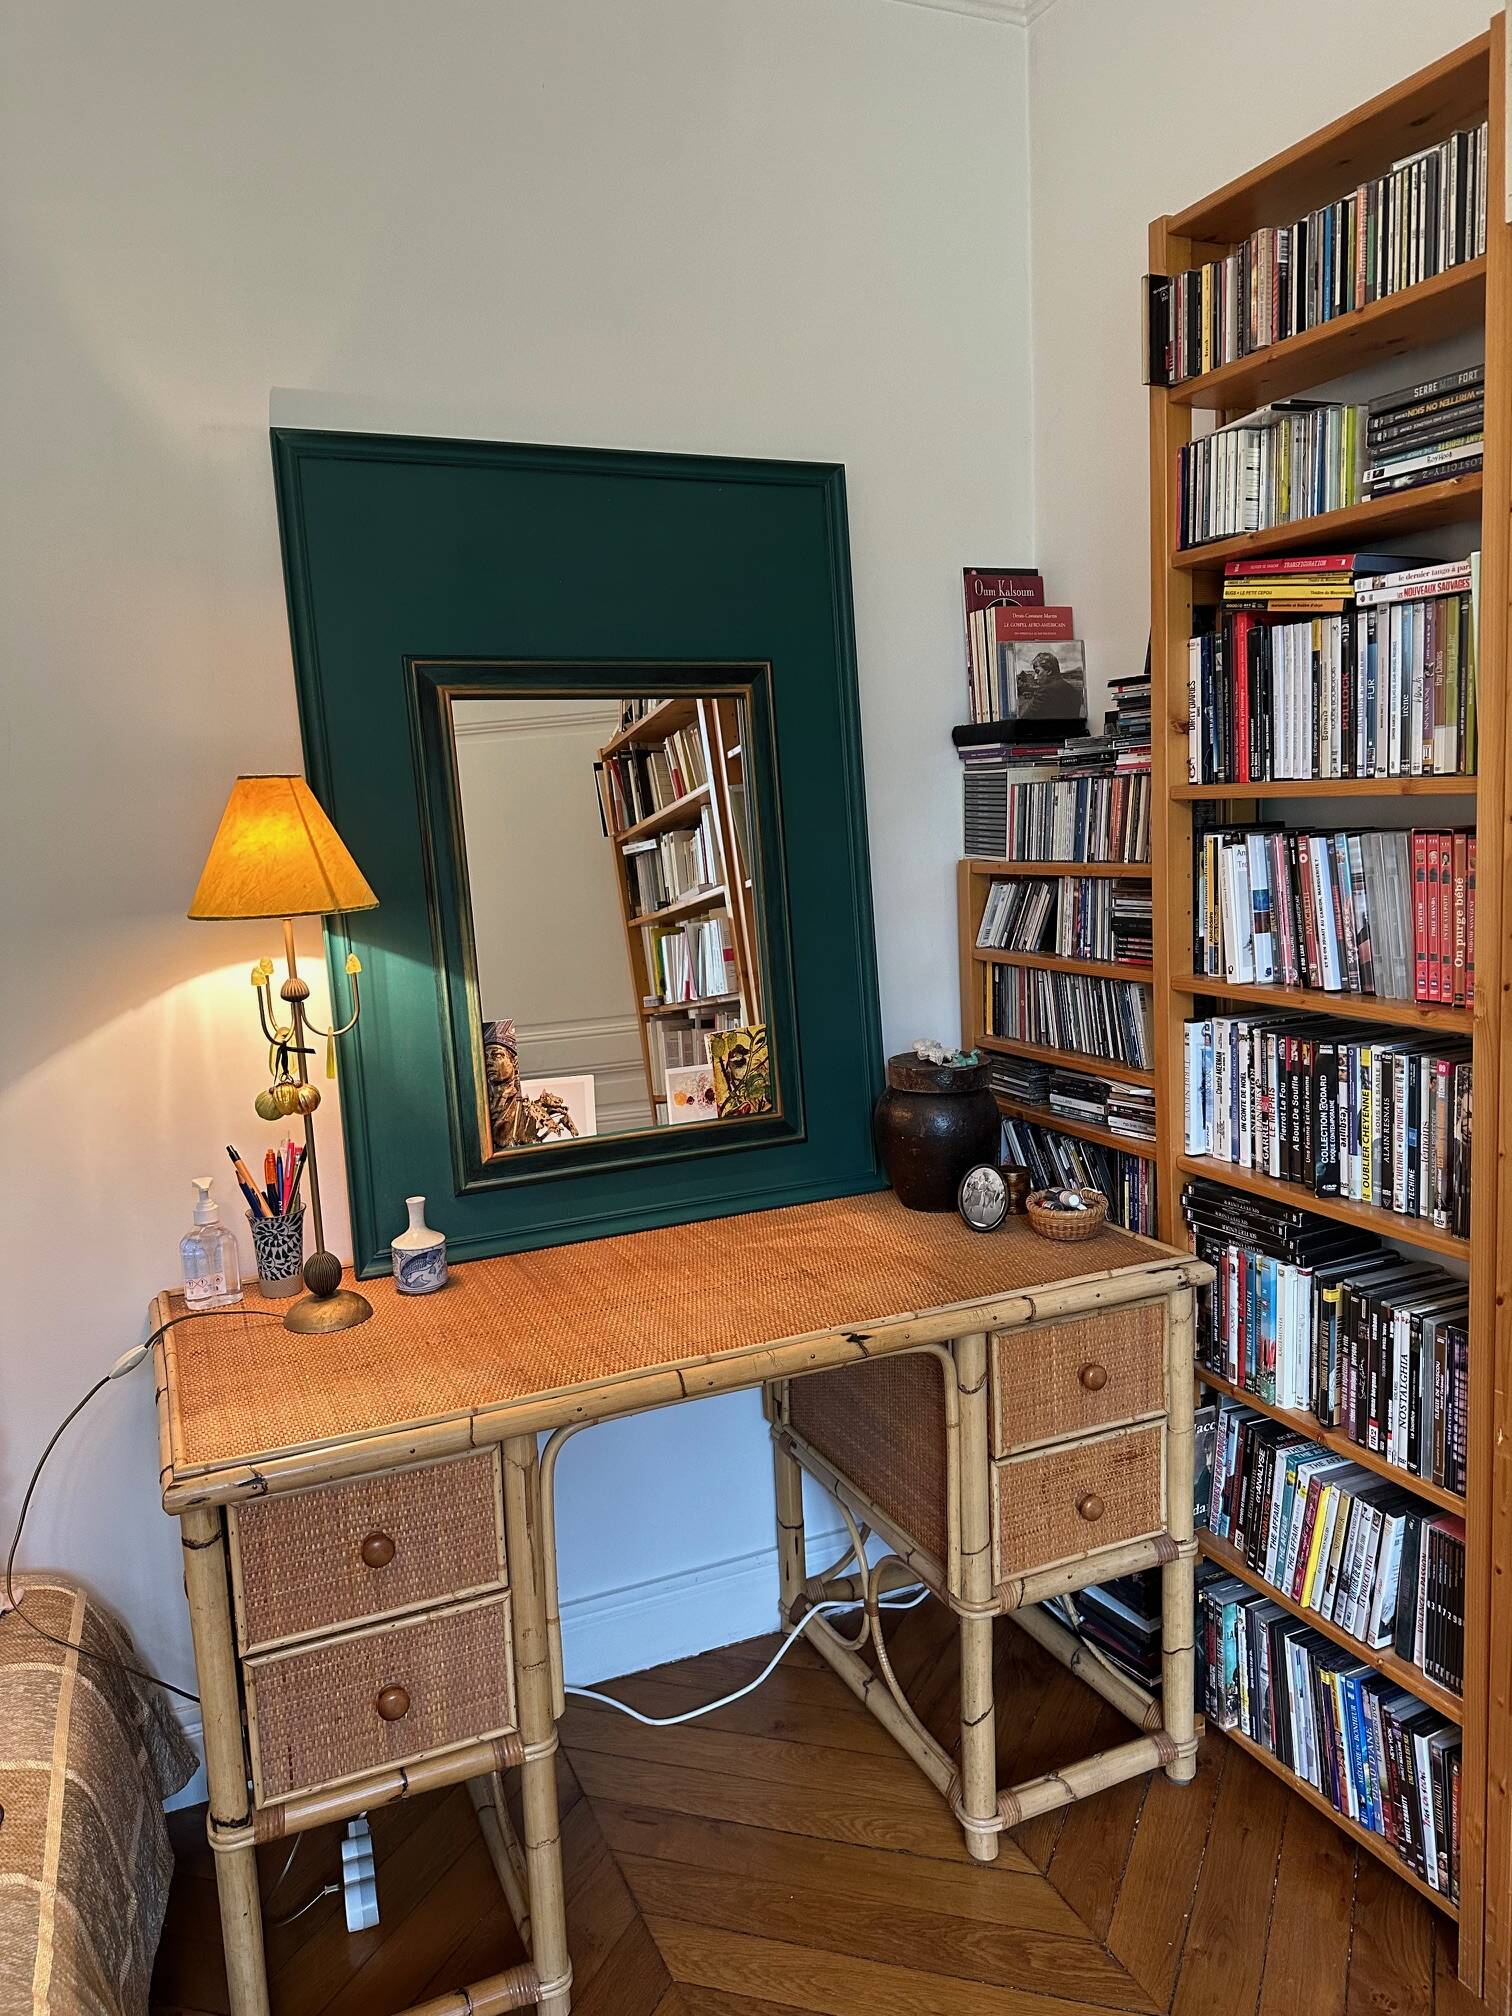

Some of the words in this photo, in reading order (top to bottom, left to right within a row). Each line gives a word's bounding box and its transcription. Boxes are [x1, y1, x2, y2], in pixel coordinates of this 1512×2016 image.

[1414, 381, 1437, 398] SERRE
[1458, 369, 1478, 385] FORT
[1407, 405, 1425, 417] SKIN
[1426, 401, 1438, 412] ON
[1439, 391, 1475, 408] WRITTEN
[1405, 571, 1430, 580] dernier
[1431, 568, 1449, 578] tango
[974, 578, 996, 597] Oum
[997, 578, 1035, 597] Kalsoum
[1403, 585, 1436, 597] NOUVEAUX
[1437, 577, 1471, 592] SAUVAGES
[1342, 671, 1350, 731] POLLOCK
[1367, 678, 1375, 700] FUR
[1454, 877, 1464, 906] bébé
[1320, 919, 1325, 927] AU
[1456, 910, 1466, 946] purge
[1323, 946, 1328, 954] ON
[1454, 949, 1464, 968] On
[1324, 960, 1329, 968] ET
[1215, 1051, 1223, 1076] AKERMAN
[1239, 1071, 1247, 1089] NOËL
[1279, 1082, 1287, 1098] Fou
[1291, 1075, 1299, 1109] Souffle
[1303, 1075, 1311, 1099] Femme
[1240, 1090, 1247, 1099] DE
[1279, 1100, 1287, 1111] Le
[1319, 1075, 1328, 1111] GODARD
[1374, 1097, 1381, 1107] LE
[1240, 1123, 1247, 1133] UN
[1279, 1112, 1287, 1141] Pierrot
[1292, 1110, 1299, 1123] De
[1328, 1100, 1336, 1143] CONTEMPORAINE
[1340, 1106, 1348, 1148] L'esquive
[1362, 1091, 1370, 1144] CHEYENNE
[1396, 1107, 1404, 1132] PURGE
[1267, 1125, 1276, 1138] LE
[1319, 1113, 1329, 1164] COLLECTION
[1396, 1134, 1403, 1143] ON
[1420, 1120, 1429, 1163] témoins
[1362, 1146, 1370, 1189] OUBLIER
[1396, 1151, 1404, 1182] CHIENNE
[1396, 1182, 1404, 1192] LA
[1221, 1223, 1238, 1234] UNDER
[1246, 1322, 1253, 1332] LA
[1320, 1349, 1328, 1366] D'UNE
[1349, 1342, 1358, 1367] persona
[1321, 1366, 1329, 1391] SOURIRES
[1341, 1357, 1349, 1384] répétition
[1370, 1371, 1378, 1397] bergman
[1399, 1353, 1408, 1429] NOSTALGHIA
[1434, 1387, 1440, 1397] DE
[1341, 1393, 1349, 1410] après
[1215, 1424, 1226, 1458] DOUCE
[1213, 1458, 1225, 1483] D'EAU
[1308, 1459, 1326, 1468] THE
[1211, 1484, 1222, 1514] CADET
[1271, 1502, 1281, 1532] AFFAIR
[1279, 1515, 1289, 1544] AFFAIR
[1270, 1532, 1278, 1551] THE
[1289, 1525, 1300, 1554] AFFAIR
[1278, 1546, 1286, 1564] THE
[1287, 1554, 1295, 1572] THE
[1353, 1556, 1363, 1571] NUIT
[1363, 1554, 1374, 1571] VITA
[1352, 1570, 1360, 1578] DE
[1419, 1552, 1428, 1587] PASSION
[1348, 1578, 1360, 1603] PORTIER
[1360, 1572, 1370, 1597] DOLCE
[1359, 1597, 1367, 1609] LA
[1416, 1597, 1425, 1634] VIOLENCE
[1350, 1704, 1361, 1742] BONHEUR
[1372, 1719, 1381, 1753] MAGICIEN
[1355, 1751, 1365, 1785] MÉLODIE
[1369, 1766, 1379, 1800] PEAU
[1400, 1793, 1410, 1823] CHARITY
[1403, 1822, 1413, 1844] SWEET
[1435, 1809, 1444, 1834] HELLO
